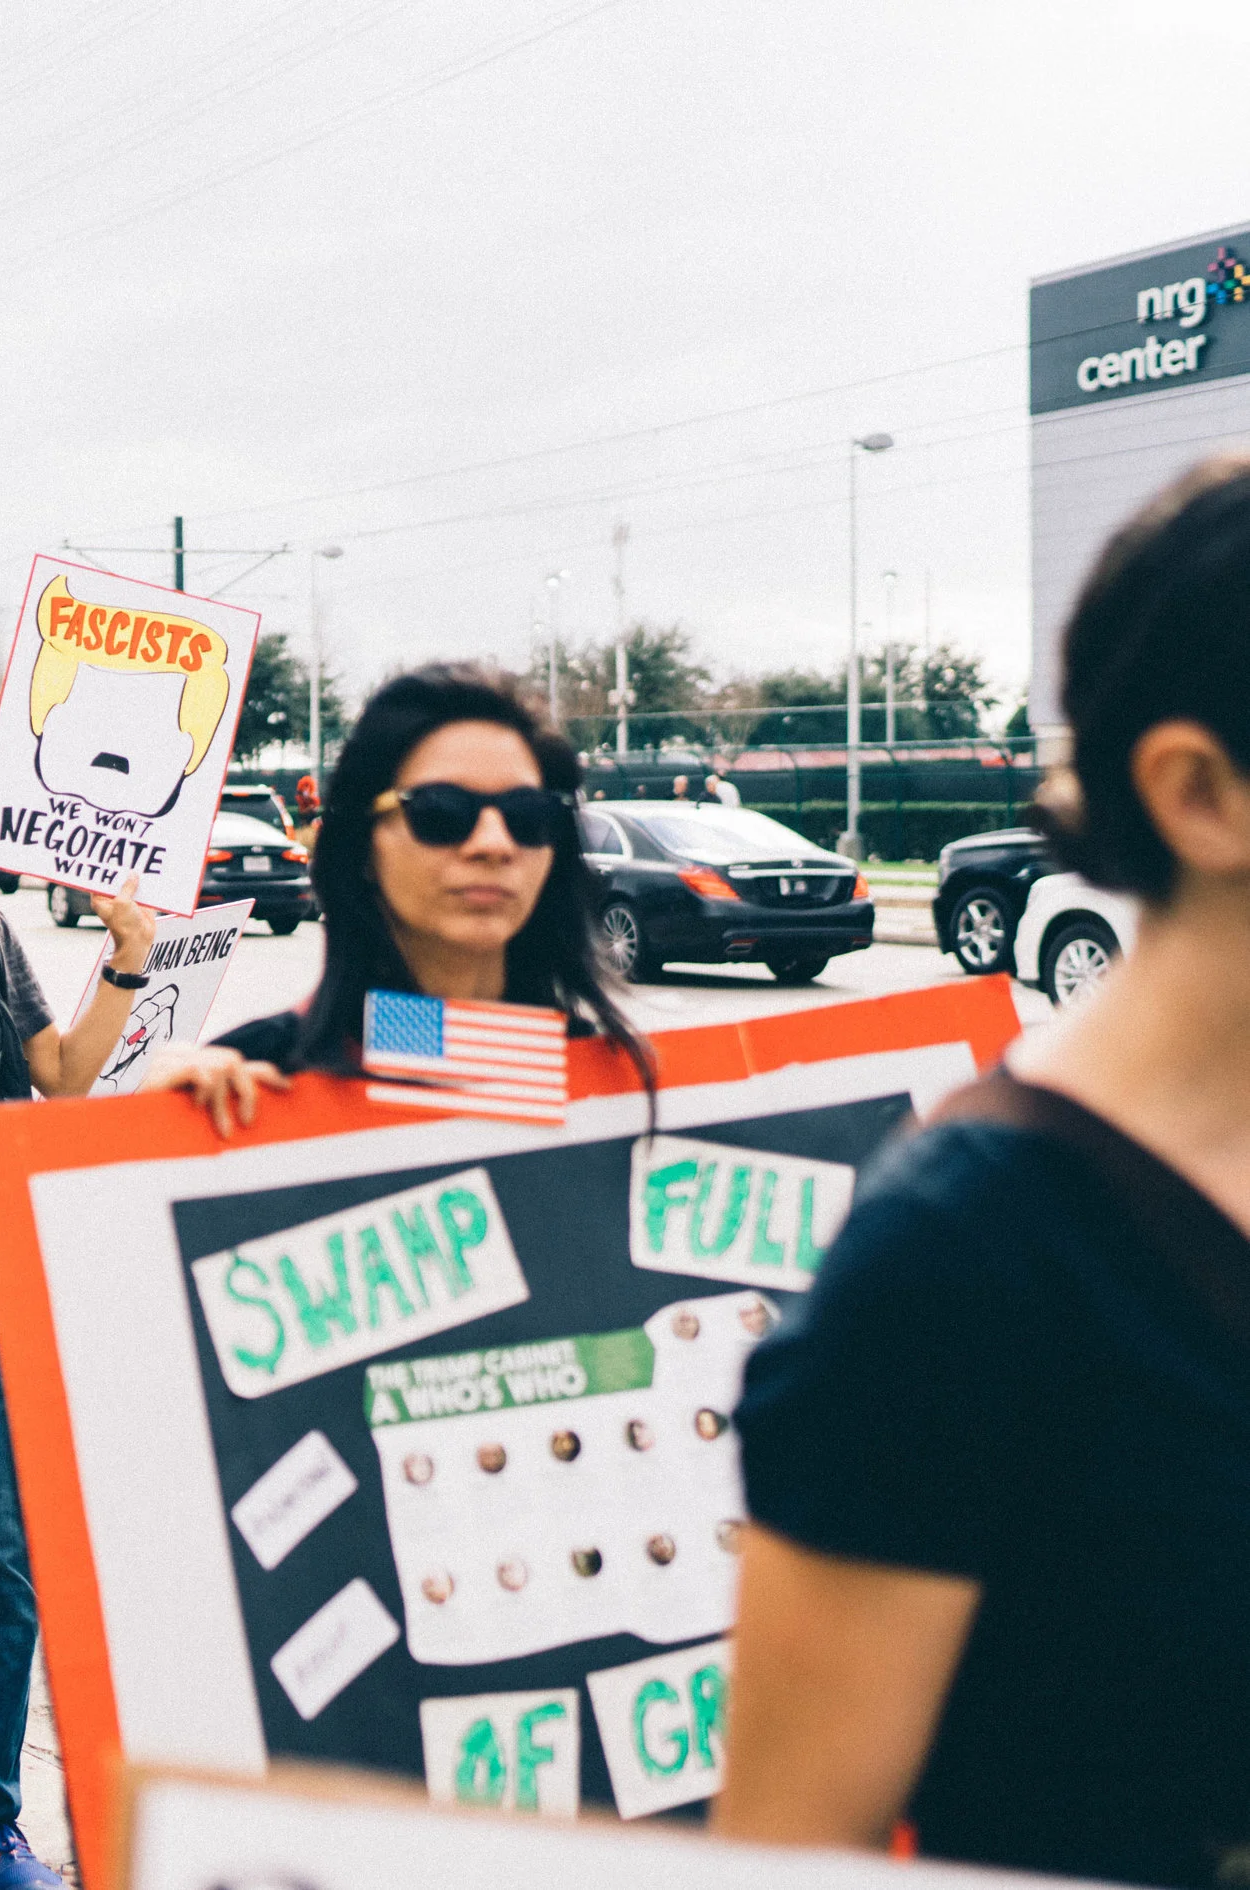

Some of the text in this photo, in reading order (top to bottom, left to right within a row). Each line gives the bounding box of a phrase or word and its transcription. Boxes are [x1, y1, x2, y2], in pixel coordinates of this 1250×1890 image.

[1137, 277, 1206, 328] nrg
[1077, 334, 1206, 391] center
[51, 596, 212, 672] FASCISTS
[0, 806, 167, 875] NEGOTIATE
[49, 797, 154, 839] WE WON'T
[55, 857, 119, 885] WITH
[141, 936, 188, 975] UMAN
[184, 928, 237, 966] BEING
[644, 1158, 830, 1273] FULL
[367, 1362, 409, 1391] THE
[410, 1352, 484, 1385] TRUMP
[370, 1390, 399, 1424] A
[504, 1363, 588, 1404] WHO
[455, 1664, 729, 1812] OF GR
